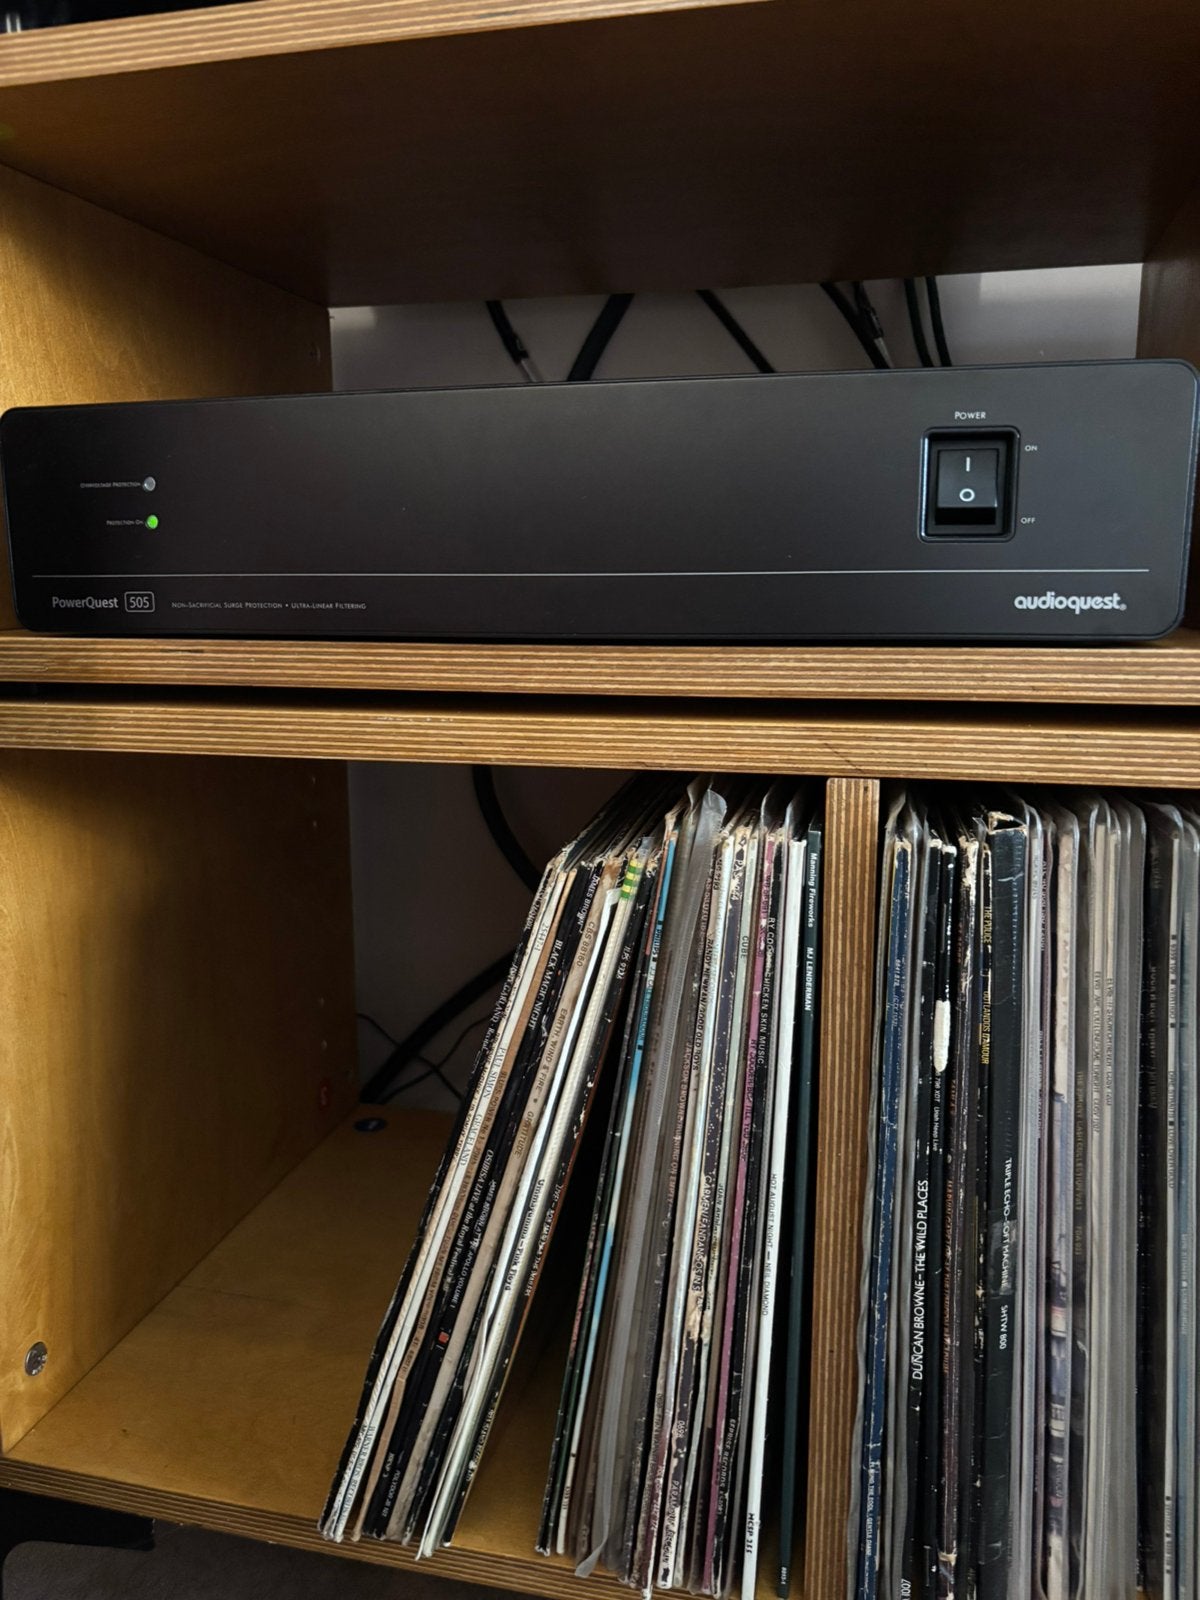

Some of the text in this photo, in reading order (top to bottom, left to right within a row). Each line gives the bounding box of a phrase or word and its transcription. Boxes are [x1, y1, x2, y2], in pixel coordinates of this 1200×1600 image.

[954, 411, 986, 420] POWER
[1024, 444, 1038, 452] ON
[1020, 516, 1036, 524] OFF
[52, 596, 150, 609] PowerQuest 505
[1014, 591, 1121, 614] audioquest
[806, 852, 818, 927] Manning Fireworks
[767, 917, 775, 928] RY
[983, 920, 991, 943] POLICE
[575, 921, 595, 967] CBS 88160
[704, 938, 713, 965] RANDY
[739, 935, 749, 958] CUBE
[526, 938, 564, 1029] BLACK MAGIC NIGHT
[761, 971, 771, 1009] CHICKEN
[803, 947, 813, 1010] MJ LENDERMAN
[760, 1012, 768, 1032] SKIN
[982, 990, 990, 1030] OUTLANDOS
[694, 1030, 702, 1047] OLD
[757, 1035, 766, 1064] MUSIC
[544, 1039, 557, 1063] WIND
[680, 1042, 693, 1082] JACKSON
[535, 1071, 547, 1091] FIRE
[459, 1046, 506, 1166] PAUL SIMON GRACELAND
[513, 1110, 535, 1157] GRATITUDE
[477, 1149, 494, 1182] OSIBISA
[669, 1161, 678, 1174] ON
[470, 1182, 483, 1201] LIVE
[666, 1176, 676, 1204] EMPTY
[463, 1210, 473, 1223] the
[767, 1192, 775, 1222] AUGUST
[455, 1223, 469, 1245] Royal
[511, 1247, 523, 1265] Pink
[1001, 1245, 1009, 1287] MACHINE
[502, 1267, 517, 1291] Floyd
[912, 1179, 930, 1380] DUNCAN BROWNE THE WILD PLACES
[761, 1280, 769, 1315] DIAMOND
